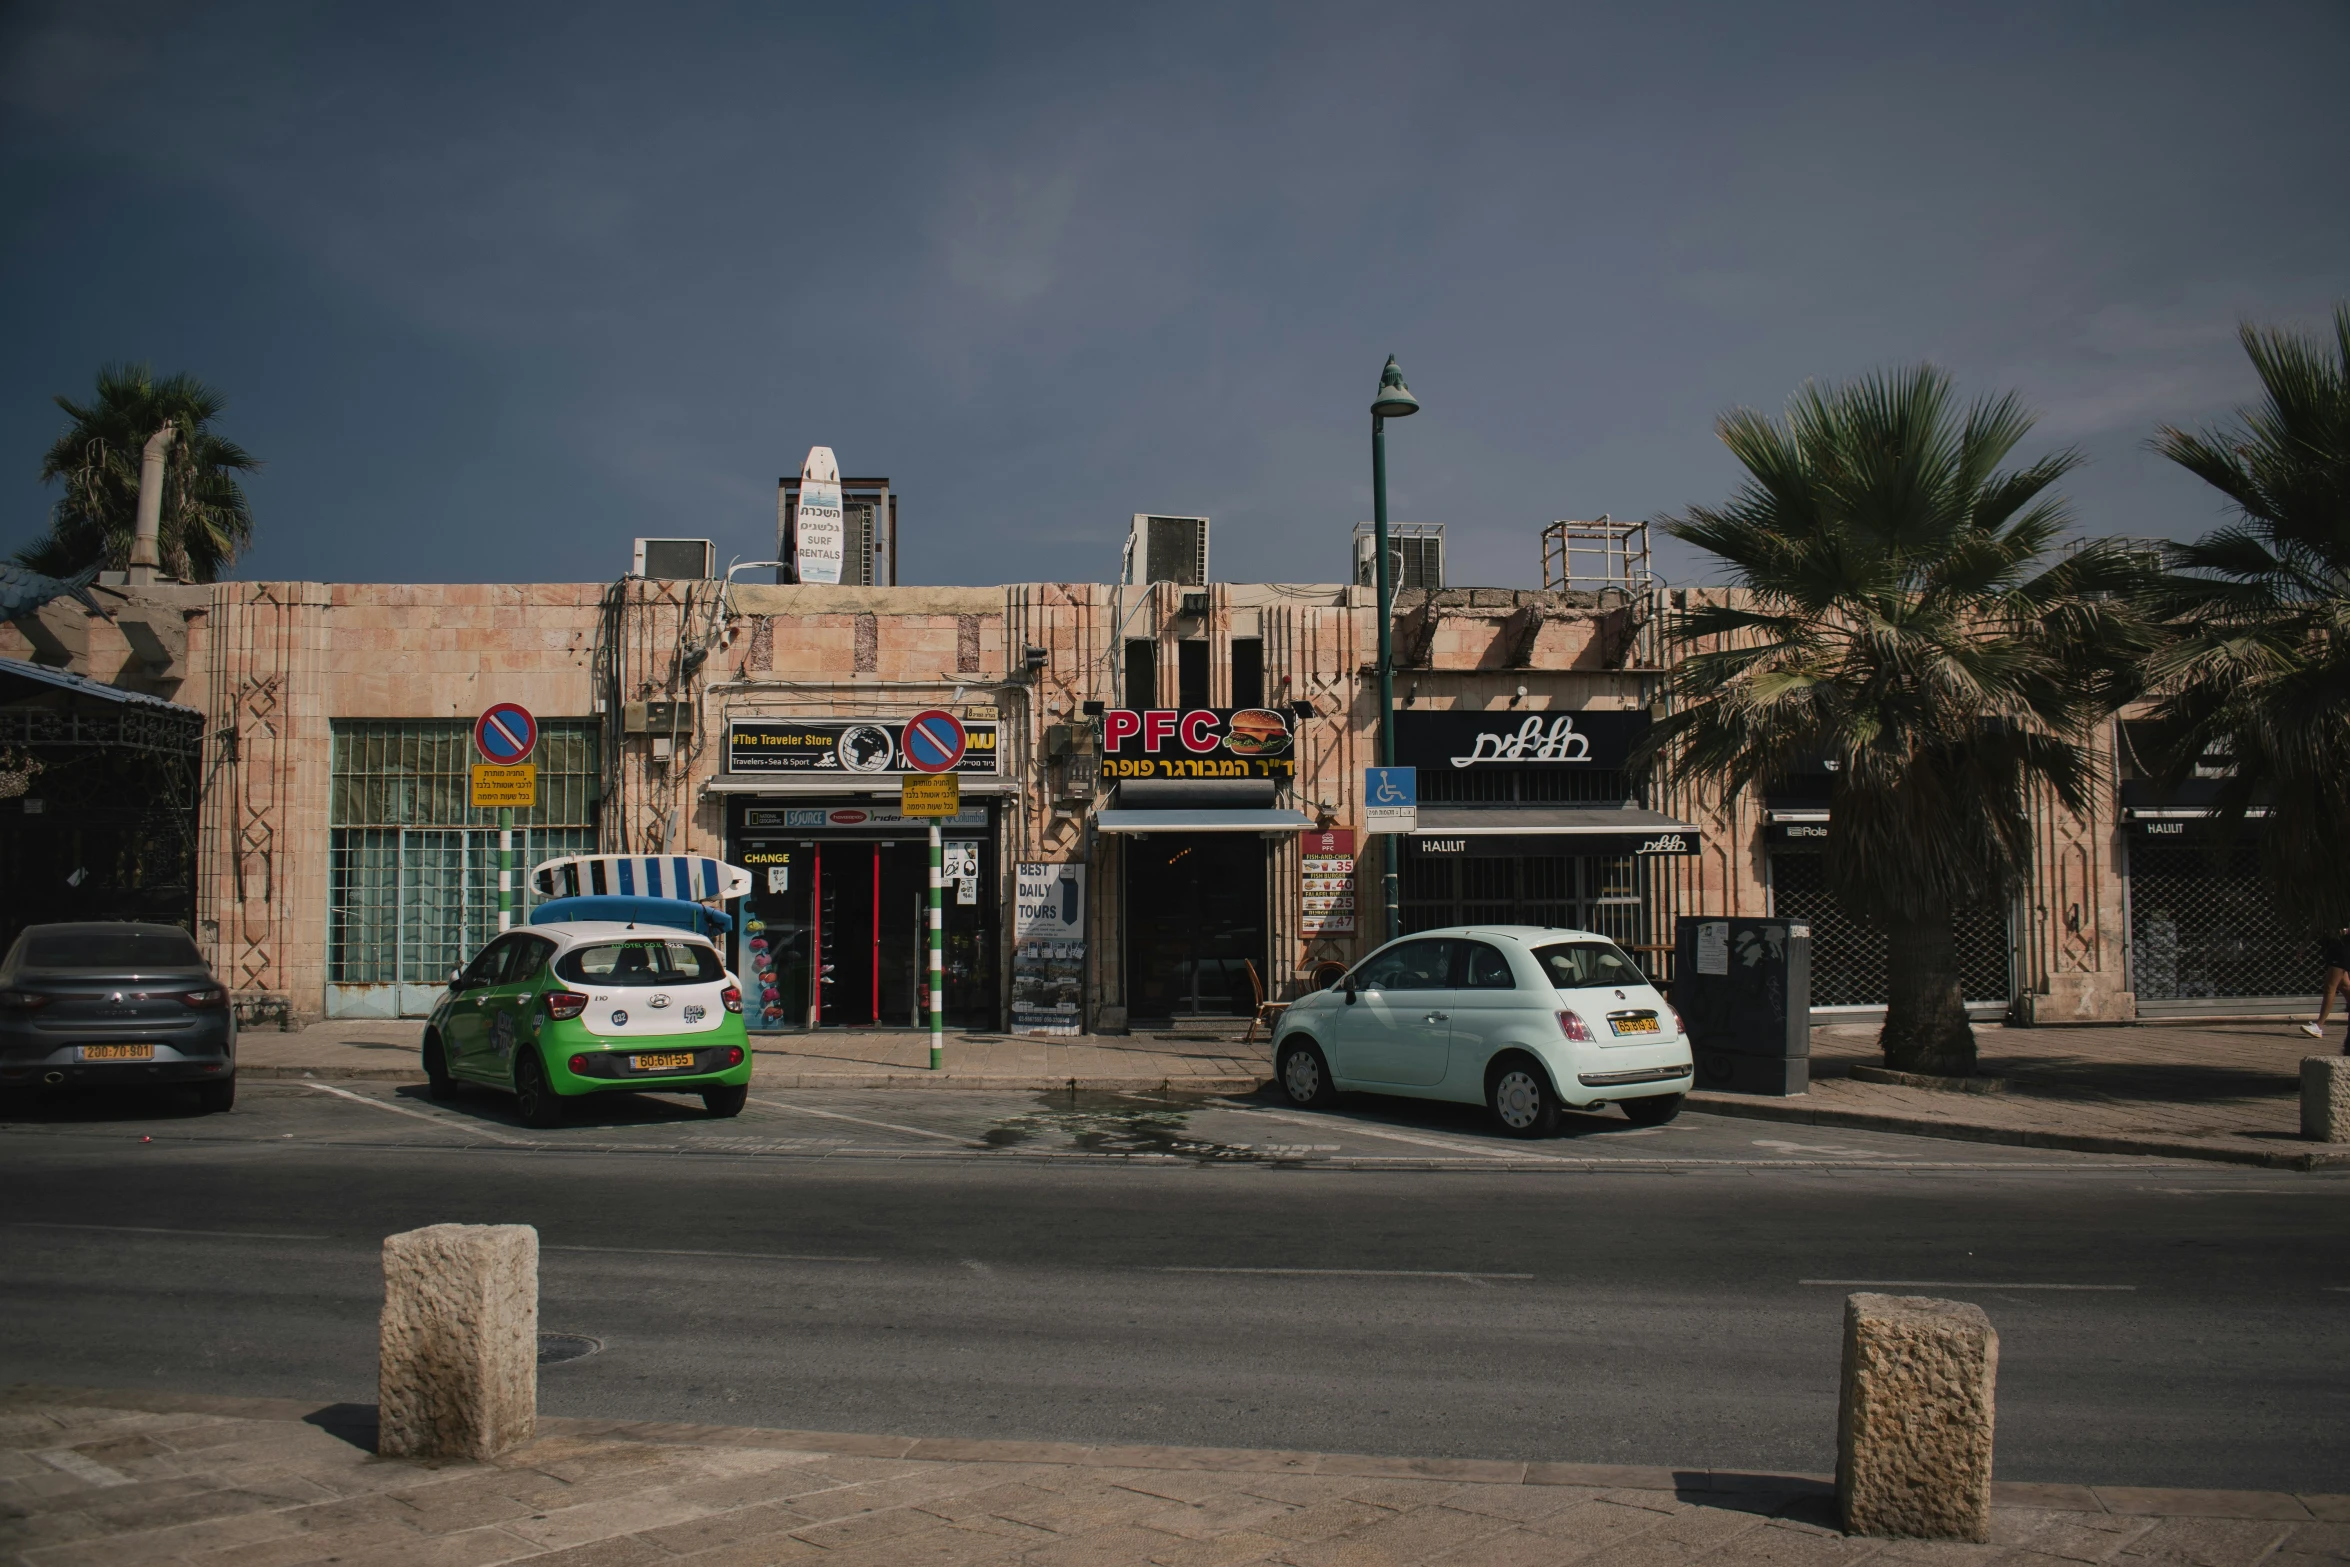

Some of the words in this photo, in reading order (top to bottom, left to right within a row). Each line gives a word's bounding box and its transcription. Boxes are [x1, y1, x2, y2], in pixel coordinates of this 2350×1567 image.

[800, 507, 840, 518] השכרת
[800, 523, 840, 532] גלשנים
[807, 536, 832, 545] SURF
[799, 549, 840, 560] RENTALS
[1103, 709, 1221, 753] PFC
[732, 733, 758, 745] #The
[760, 734, 803, 746] Traveler
[804, 734, 833, 746] Store
[1450, 715, 1593, 768] חלילית
[732, 758, 764, 766] Travelers
[768, 758, 782, 766] Sea
[783, 758, 789, 766] &
[790, 758, 810, 767] Sport
[1102, 759, 1156, 777] פופה
[1159, 759, 1250, 777] המבורגר
[518, 792, 530, 800] בכל
[905, 791, 919, 799] בלבד
[789, 811, 823, 826] SOURCE
[873, 814, 905, 822] rider
[953, 811, 985, 823] Columbia
[1802, 826, 1828, 837] Rola
[2147, 823, 2184, 834] HALILIT
[1422, 840, 1466, 852] HALILIT
[744, 853, 790, 864] CHANGE
[1020, 864, 1049, 876] BEST
[1336, 861, 1352, 871] 35
[1019, 883, 1051, 897] DAILY
[1336, 880, 1353, 890] 40
[1336, 898, 1353, 908] 25
[1018, 904, 1057, 919] TOURS
[1336, 917, 1353, 926] 47
